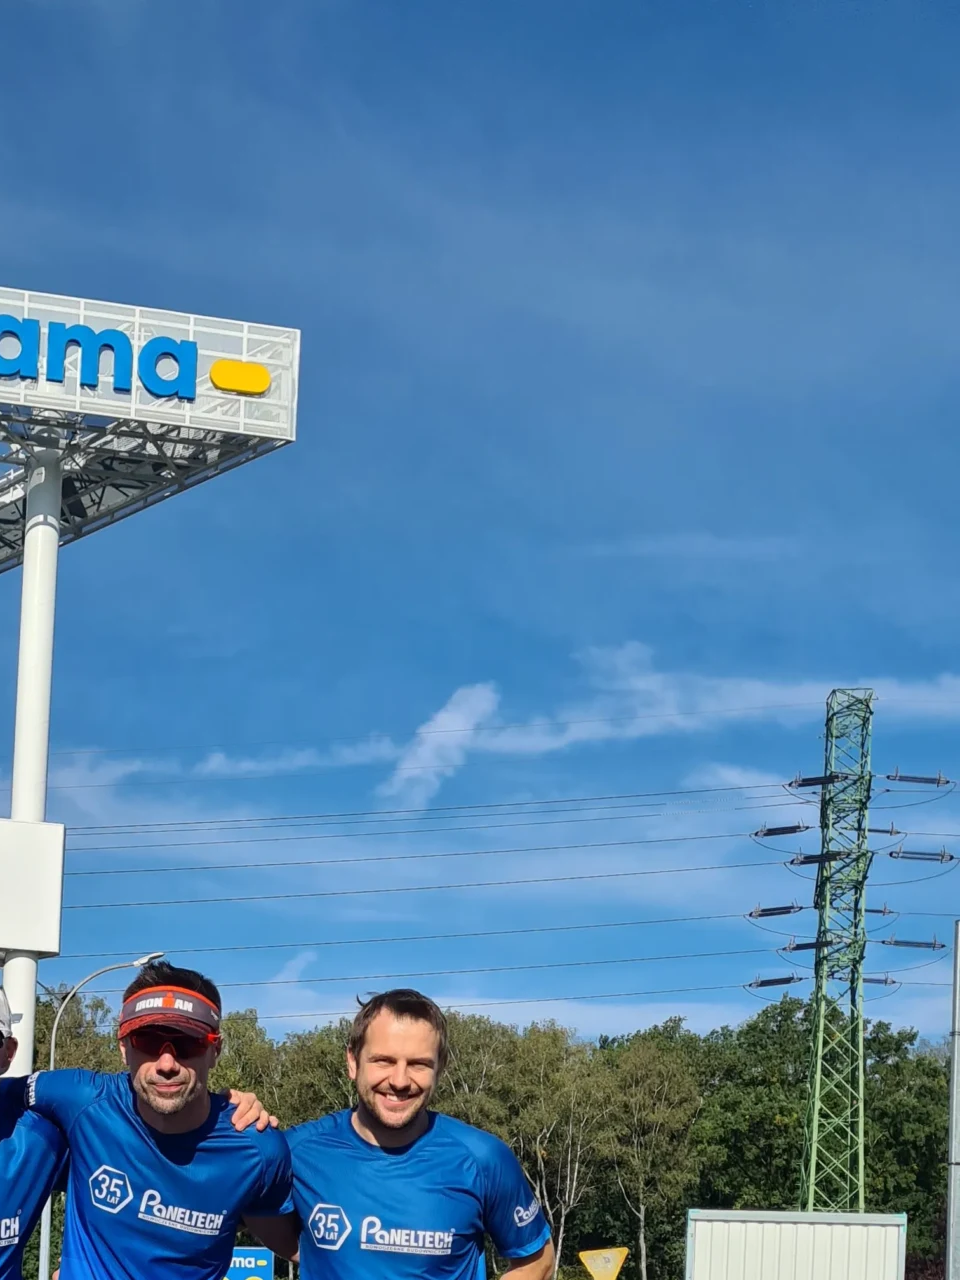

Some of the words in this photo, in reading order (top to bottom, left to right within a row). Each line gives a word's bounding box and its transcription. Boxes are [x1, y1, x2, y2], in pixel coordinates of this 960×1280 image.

[94, 1173, 124, 1199] 35
[107, 1194, 120, 1205] LAT
[314, 1212, 340, 1239] 35
[325, 1231, 339, 1240] LAT
